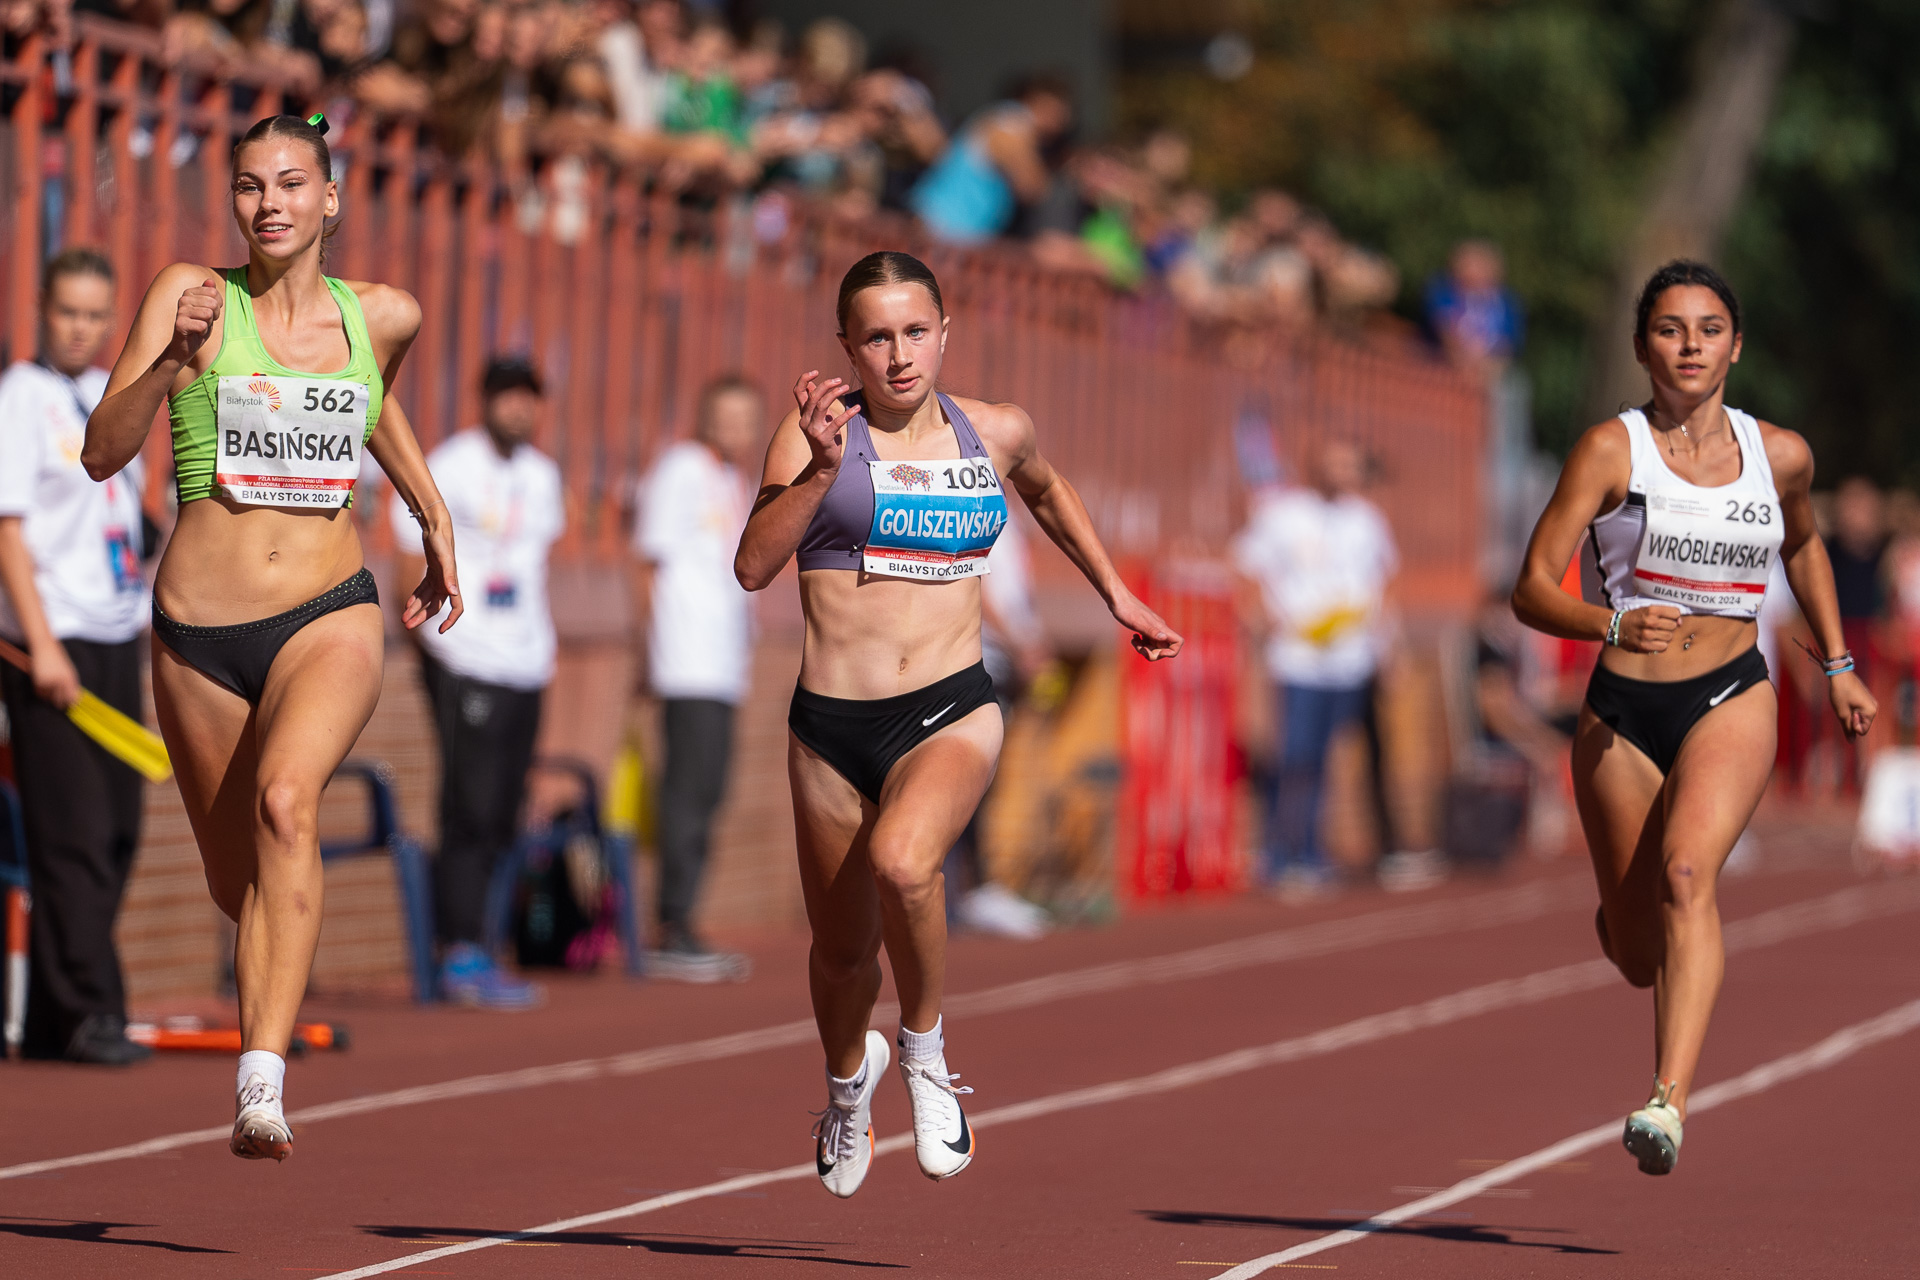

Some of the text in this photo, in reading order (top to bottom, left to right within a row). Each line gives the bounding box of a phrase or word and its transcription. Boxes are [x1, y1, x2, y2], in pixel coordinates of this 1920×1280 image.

[226, 395, 264, 408] Białystok
[303, 387, 356, 414] 562
[225, 426, 354, 462] BASIŃSKA
[943, 464, 997, 490] 1053
[242, 490, 339, 503] BIAŁYSTOK 2024
[879, 508, 1002, 539] GOLISZEWSKA
[1726, 500, 1771, 525] 263
[900, 554, 926, 562] MEMORIAŁ
[1648, 532, 1769, 569] WRÓBLEWSKA
[888, 562, 973, 577] BIAŁYSTOK 2024
[1653, 586, 1741, 605] BIAŁYSTOK 2024
